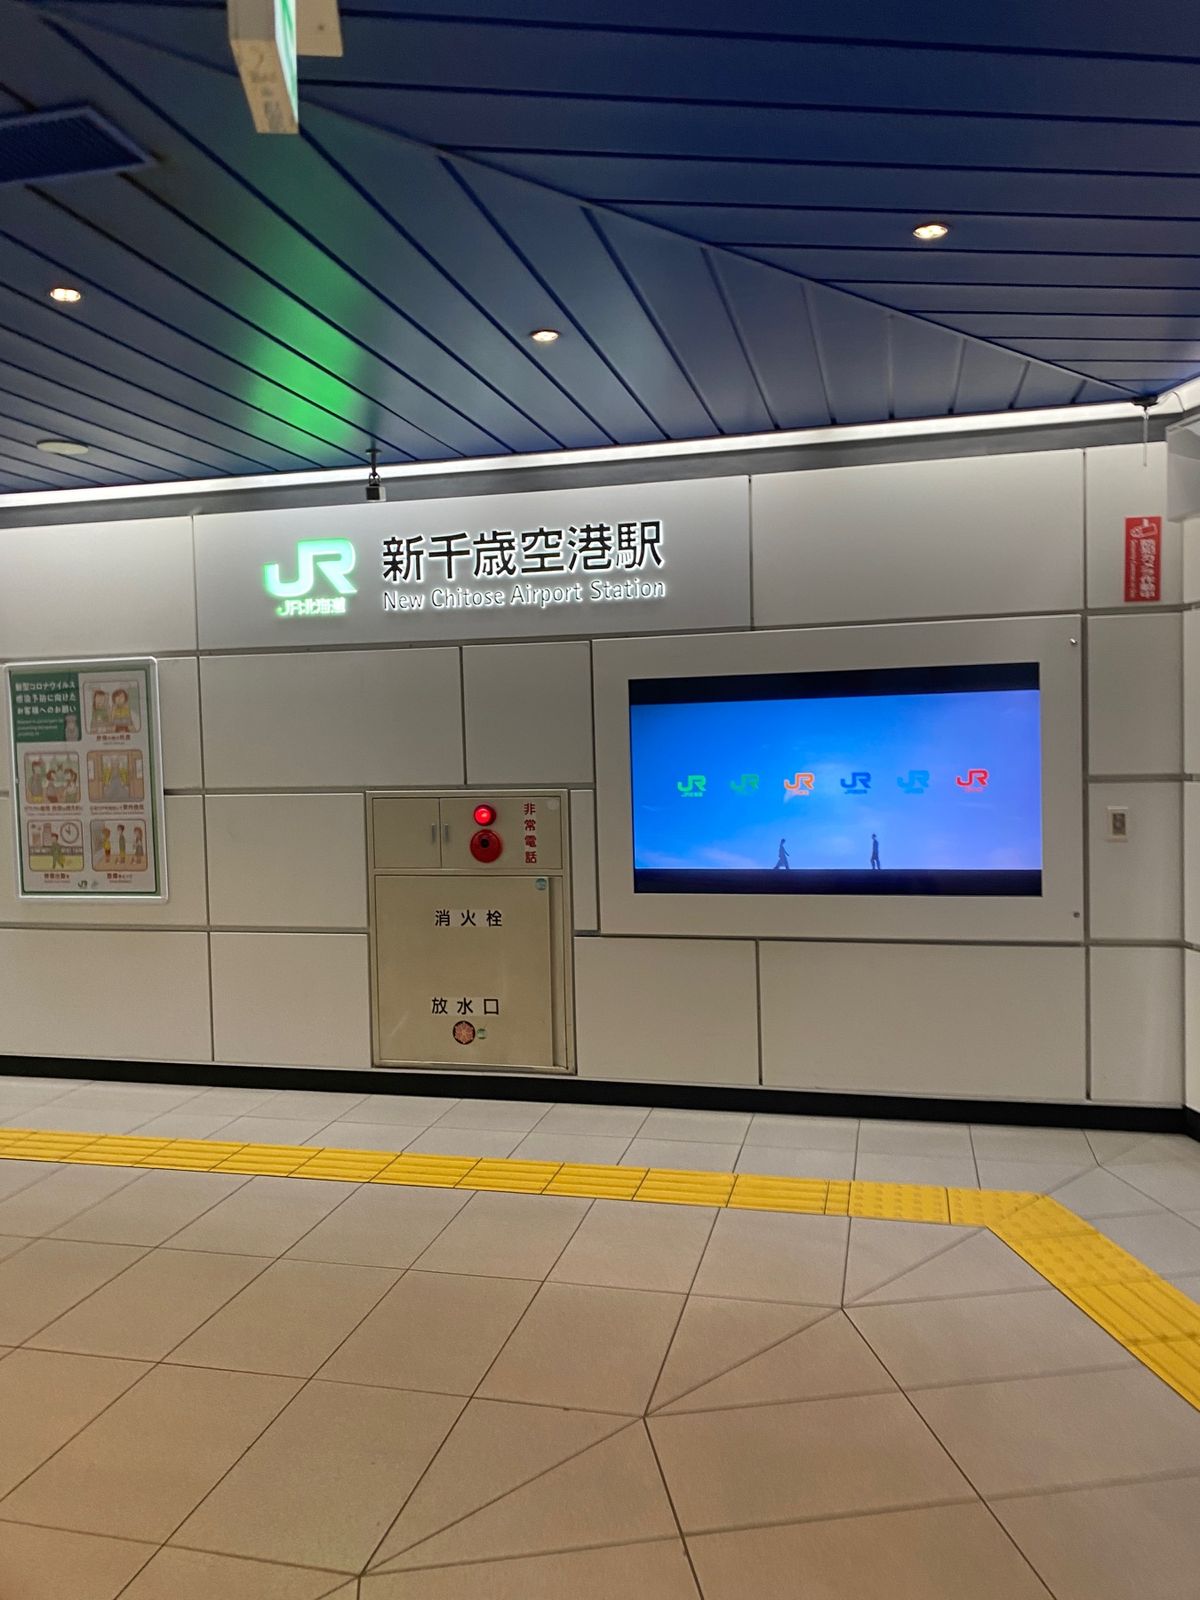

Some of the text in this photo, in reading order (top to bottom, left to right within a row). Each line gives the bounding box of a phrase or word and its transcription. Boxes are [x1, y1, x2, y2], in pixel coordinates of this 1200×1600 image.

[382, 521, 664, 583] 新千歳空港駅
[262, 538, 358, 597] JR
[383, 578, 666, 611] New Chitose Airport Station
[678, 774, 706, 792] JR
[784, 772, 814, 790] JR
[840, 771, 872, 789] JR
[956, 769, 989, 787] JR
[523, 803, 537, 864] 非常電話
[435, 909, 502, 927] 消火栓
[431, 997, 500, 1015] 放水口
